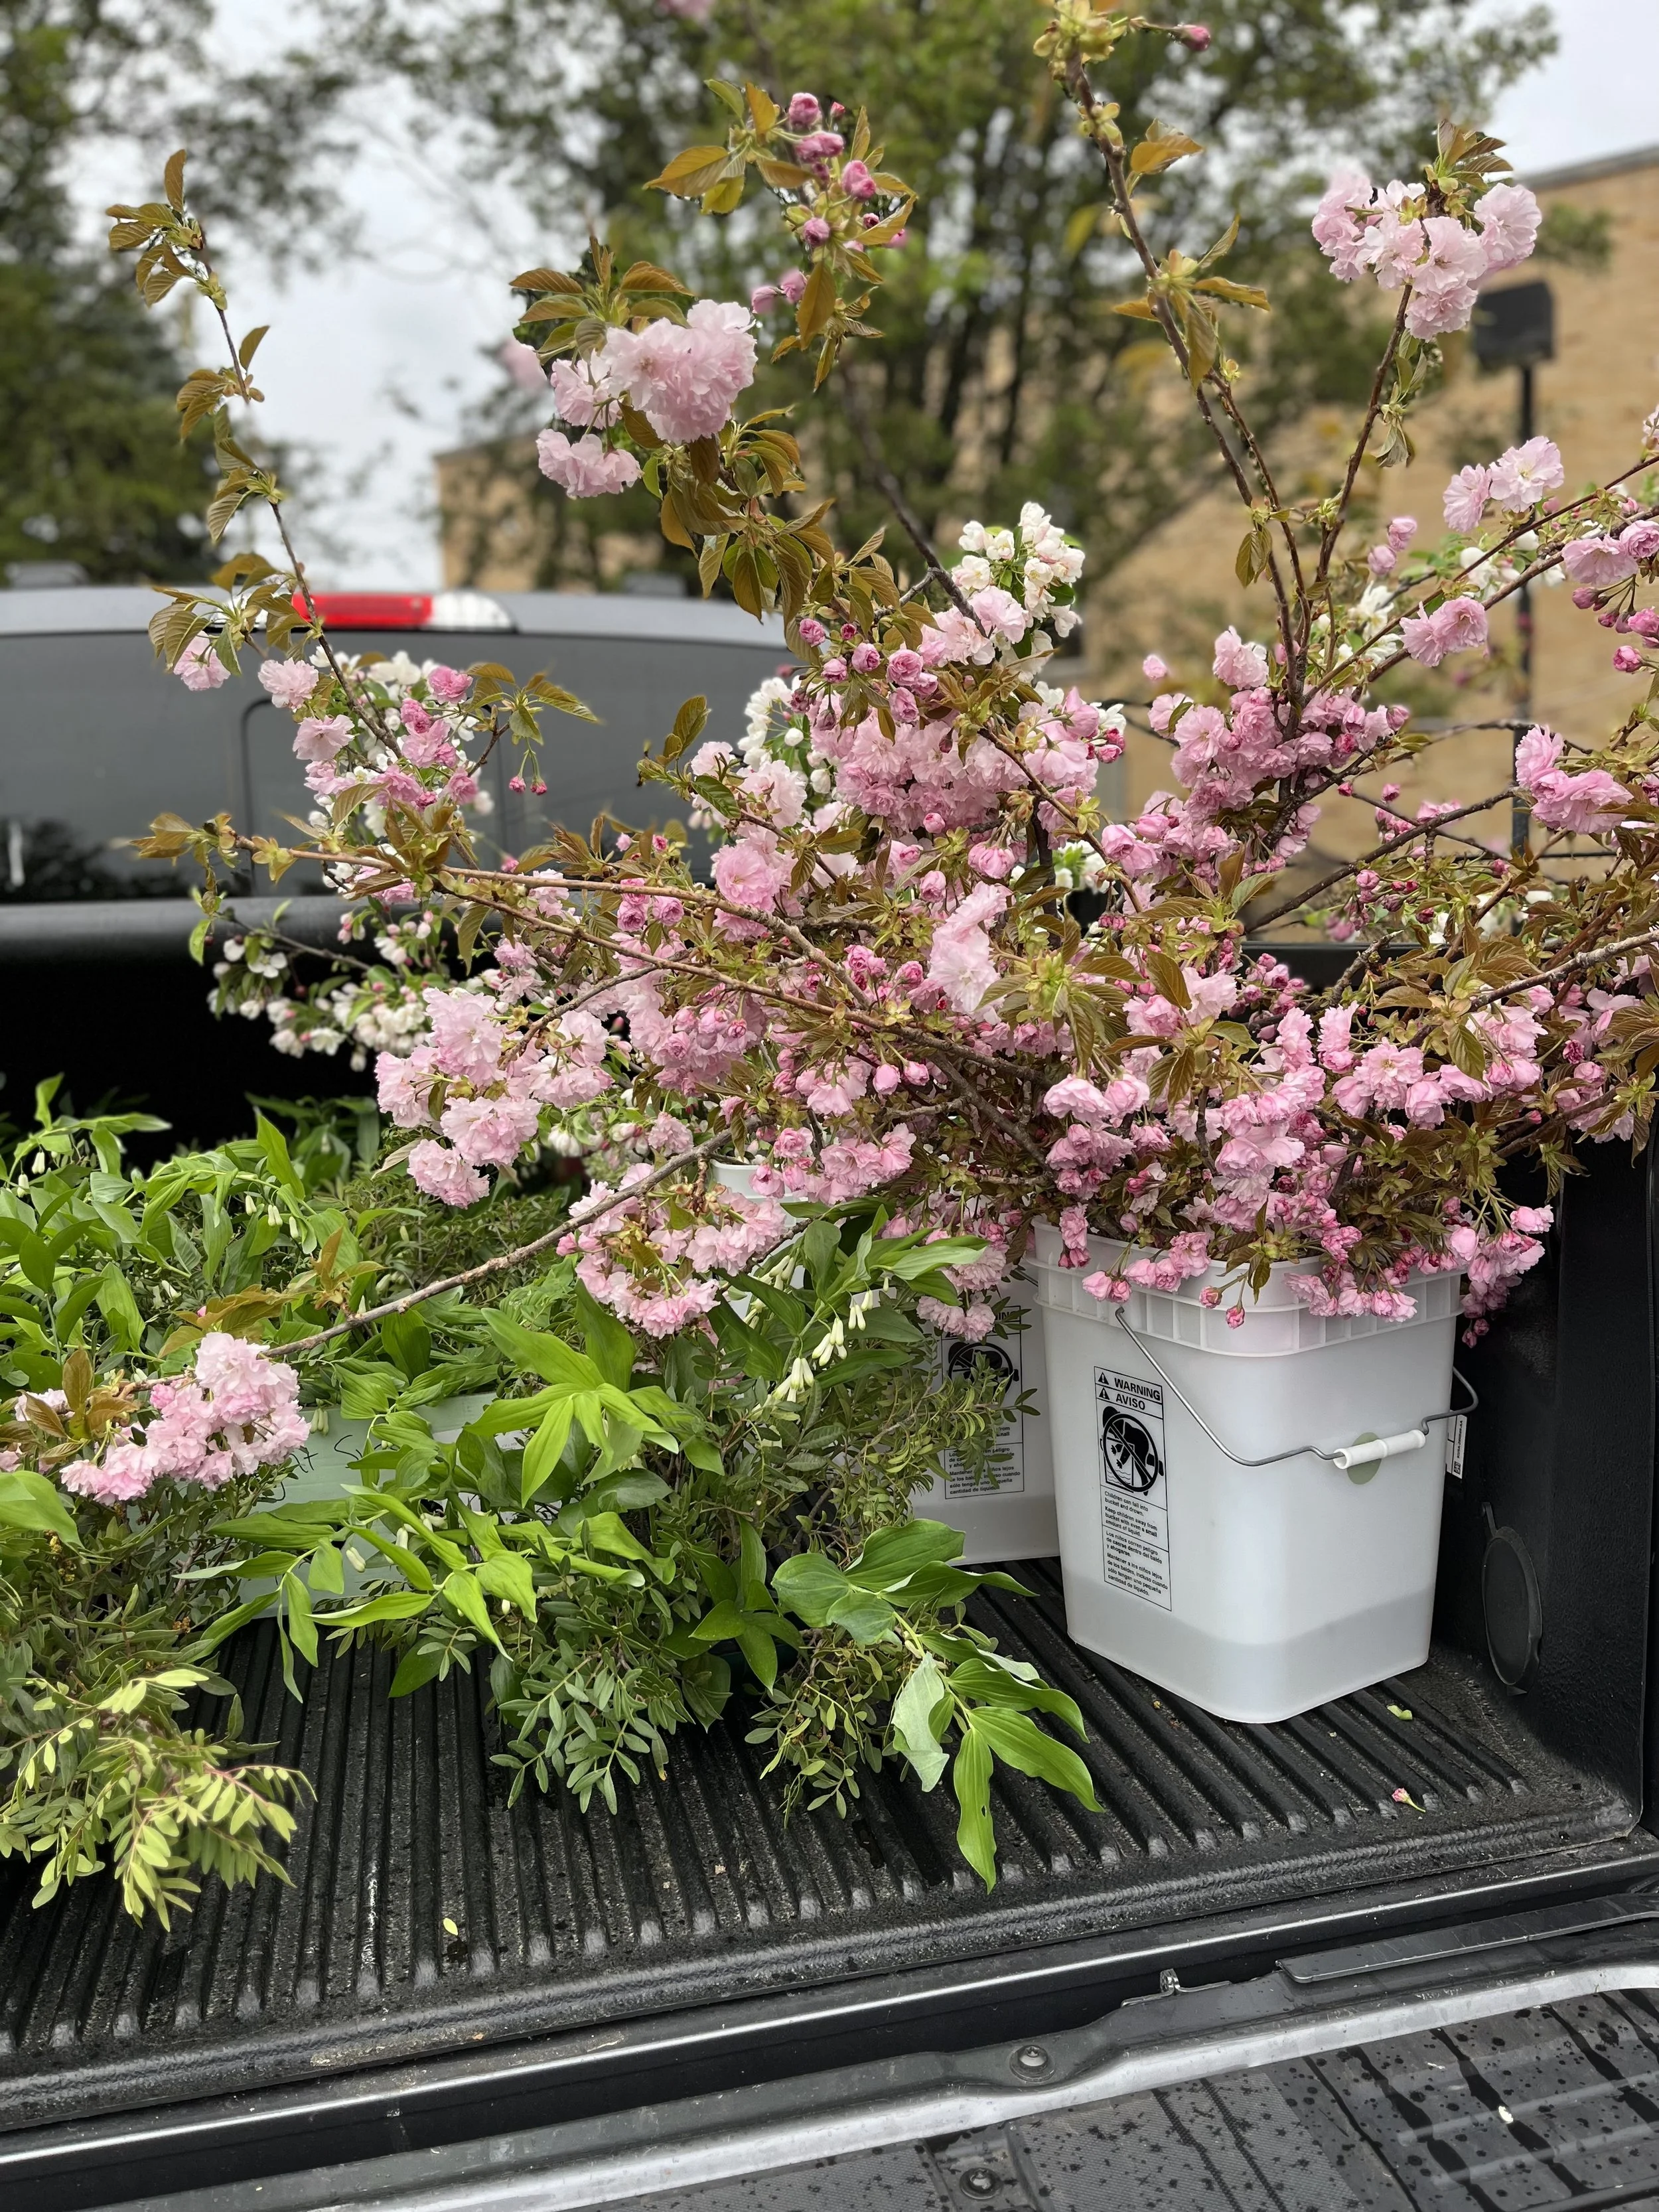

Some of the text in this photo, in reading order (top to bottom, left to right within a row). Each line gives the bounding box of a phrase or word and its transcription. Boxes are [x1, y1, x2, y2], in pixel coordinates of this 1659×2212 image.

[1114, 1378, 1160, 1400] WARNING
[1116, 1394, 1145, 1410] AVISO
[1104, 1491, 1122, 1501] Children
[1105, 1497, 1119, 1507] bucket
[1129, 1507, 1144, 1516] drown.
[1105, 1506, 1116, 1514] Keep
[1117, 1511, 1135, 1521] children
[1106, 1512, 1119, 1522] bucket
[1106, 1520, 1121, 1529] amount
[1128, 1528, 1141, 1536] liquid.
[1111, 1545, 1131, 1557] ahogarse.
[1113, 1540, 1127, 1549] caerse
[1128, 1546, 1141, 1555] dentro
[1150, 1554, 1162, 1564] balde
[1128, 1540, 1141, 1549] corren
[1143, 1546, 1158, 1556] peligro
[1107, 1553, 1127, 1564] Mantener
[1108, 1574, 1126, 1585] cantidad
[1118, 1572, 1132, 1581] tengan
[1143, 1582, 1161, 1594] pequeña
[1121, 1565, 1135, 1576] baldes,
[1136, 1572, 1151, 1582] incluso
[1152, 1580, 1168, 1590] cuando
